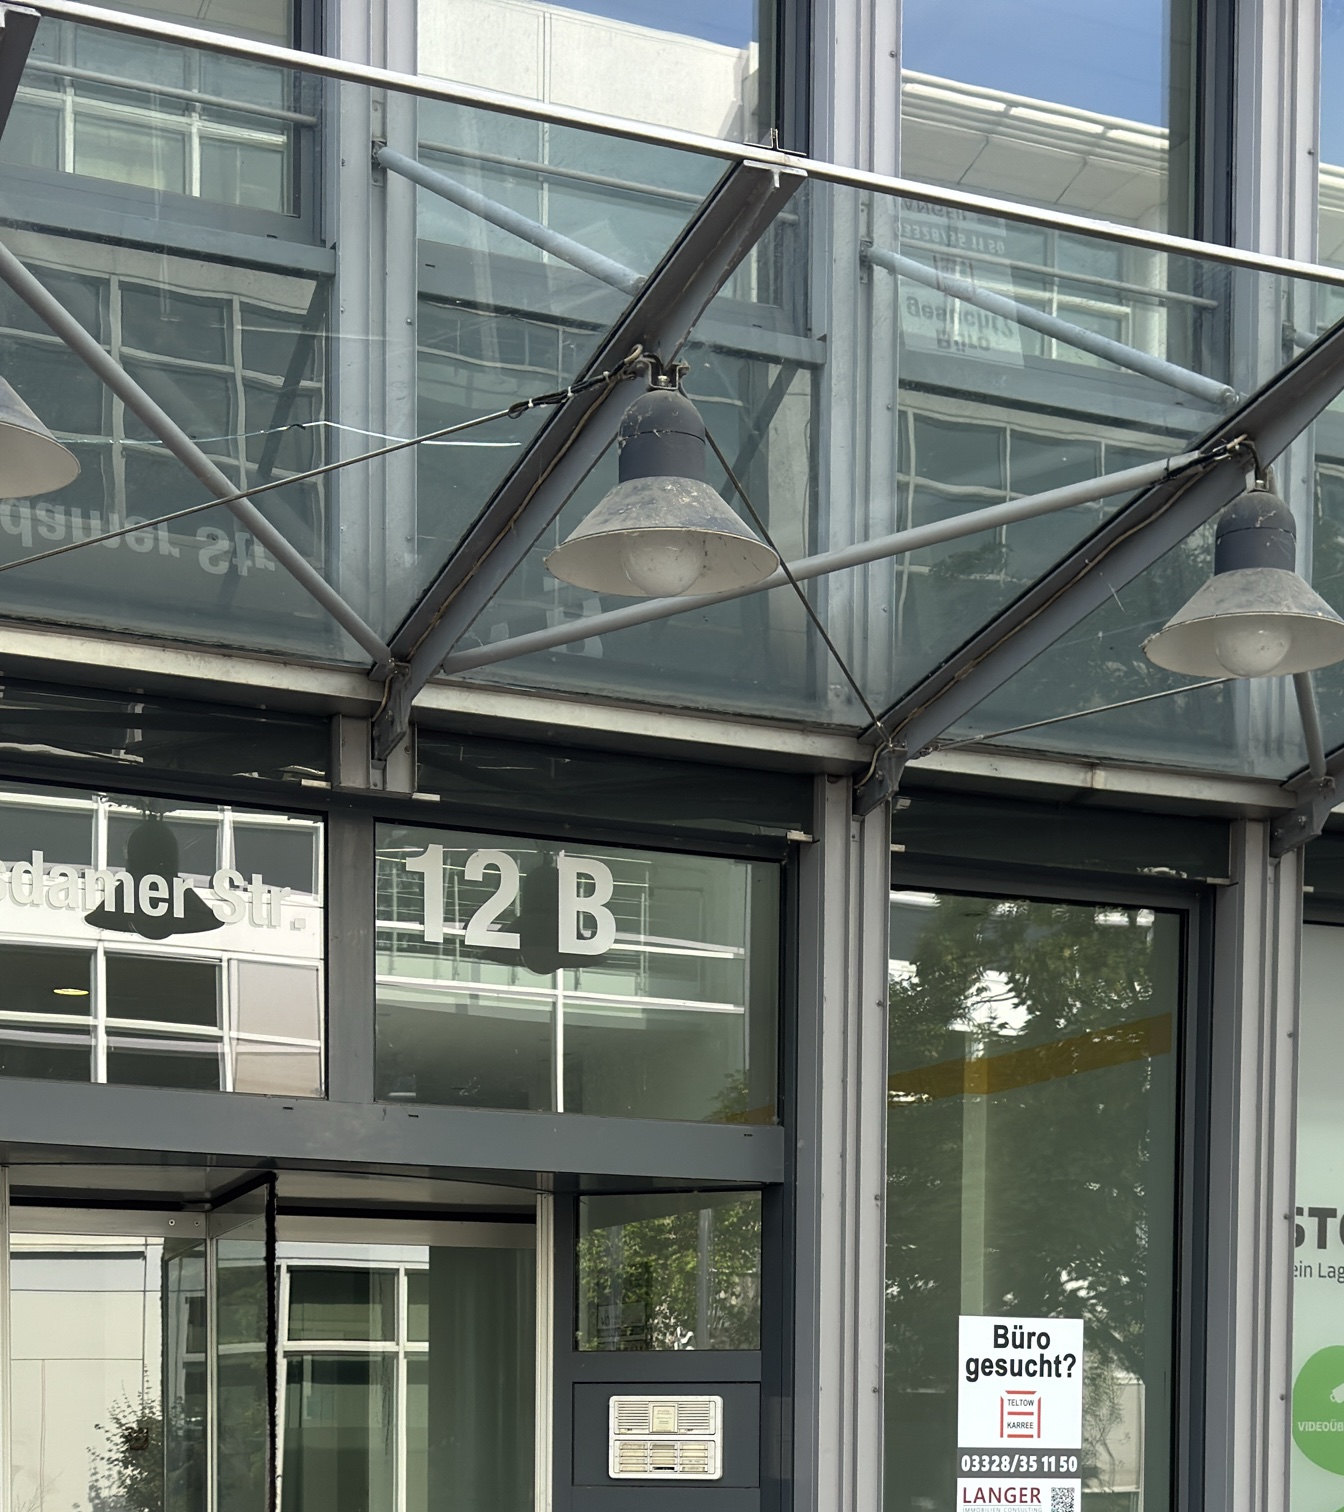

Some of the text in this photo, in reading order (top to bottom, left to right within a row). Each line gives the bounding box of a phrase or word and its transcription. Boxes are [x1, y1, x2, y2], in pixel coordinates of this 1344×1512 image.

[212, 868, 307, 930] Str.
[405, 845, 521, 948] 12
[558, 850, 617, 955] B
[993, 1324, 1051, 1350] Büro
[965, 1353, 1077, 1382] gesucht?
[1007, 1399, 1035, 1407] TELTOW
[1007, 1421, 1034, 1429] KARREE
[961, 1455, 1078, 1473] 03328/35 11 50
[962, 1487, 1041, 1504] LANGER
